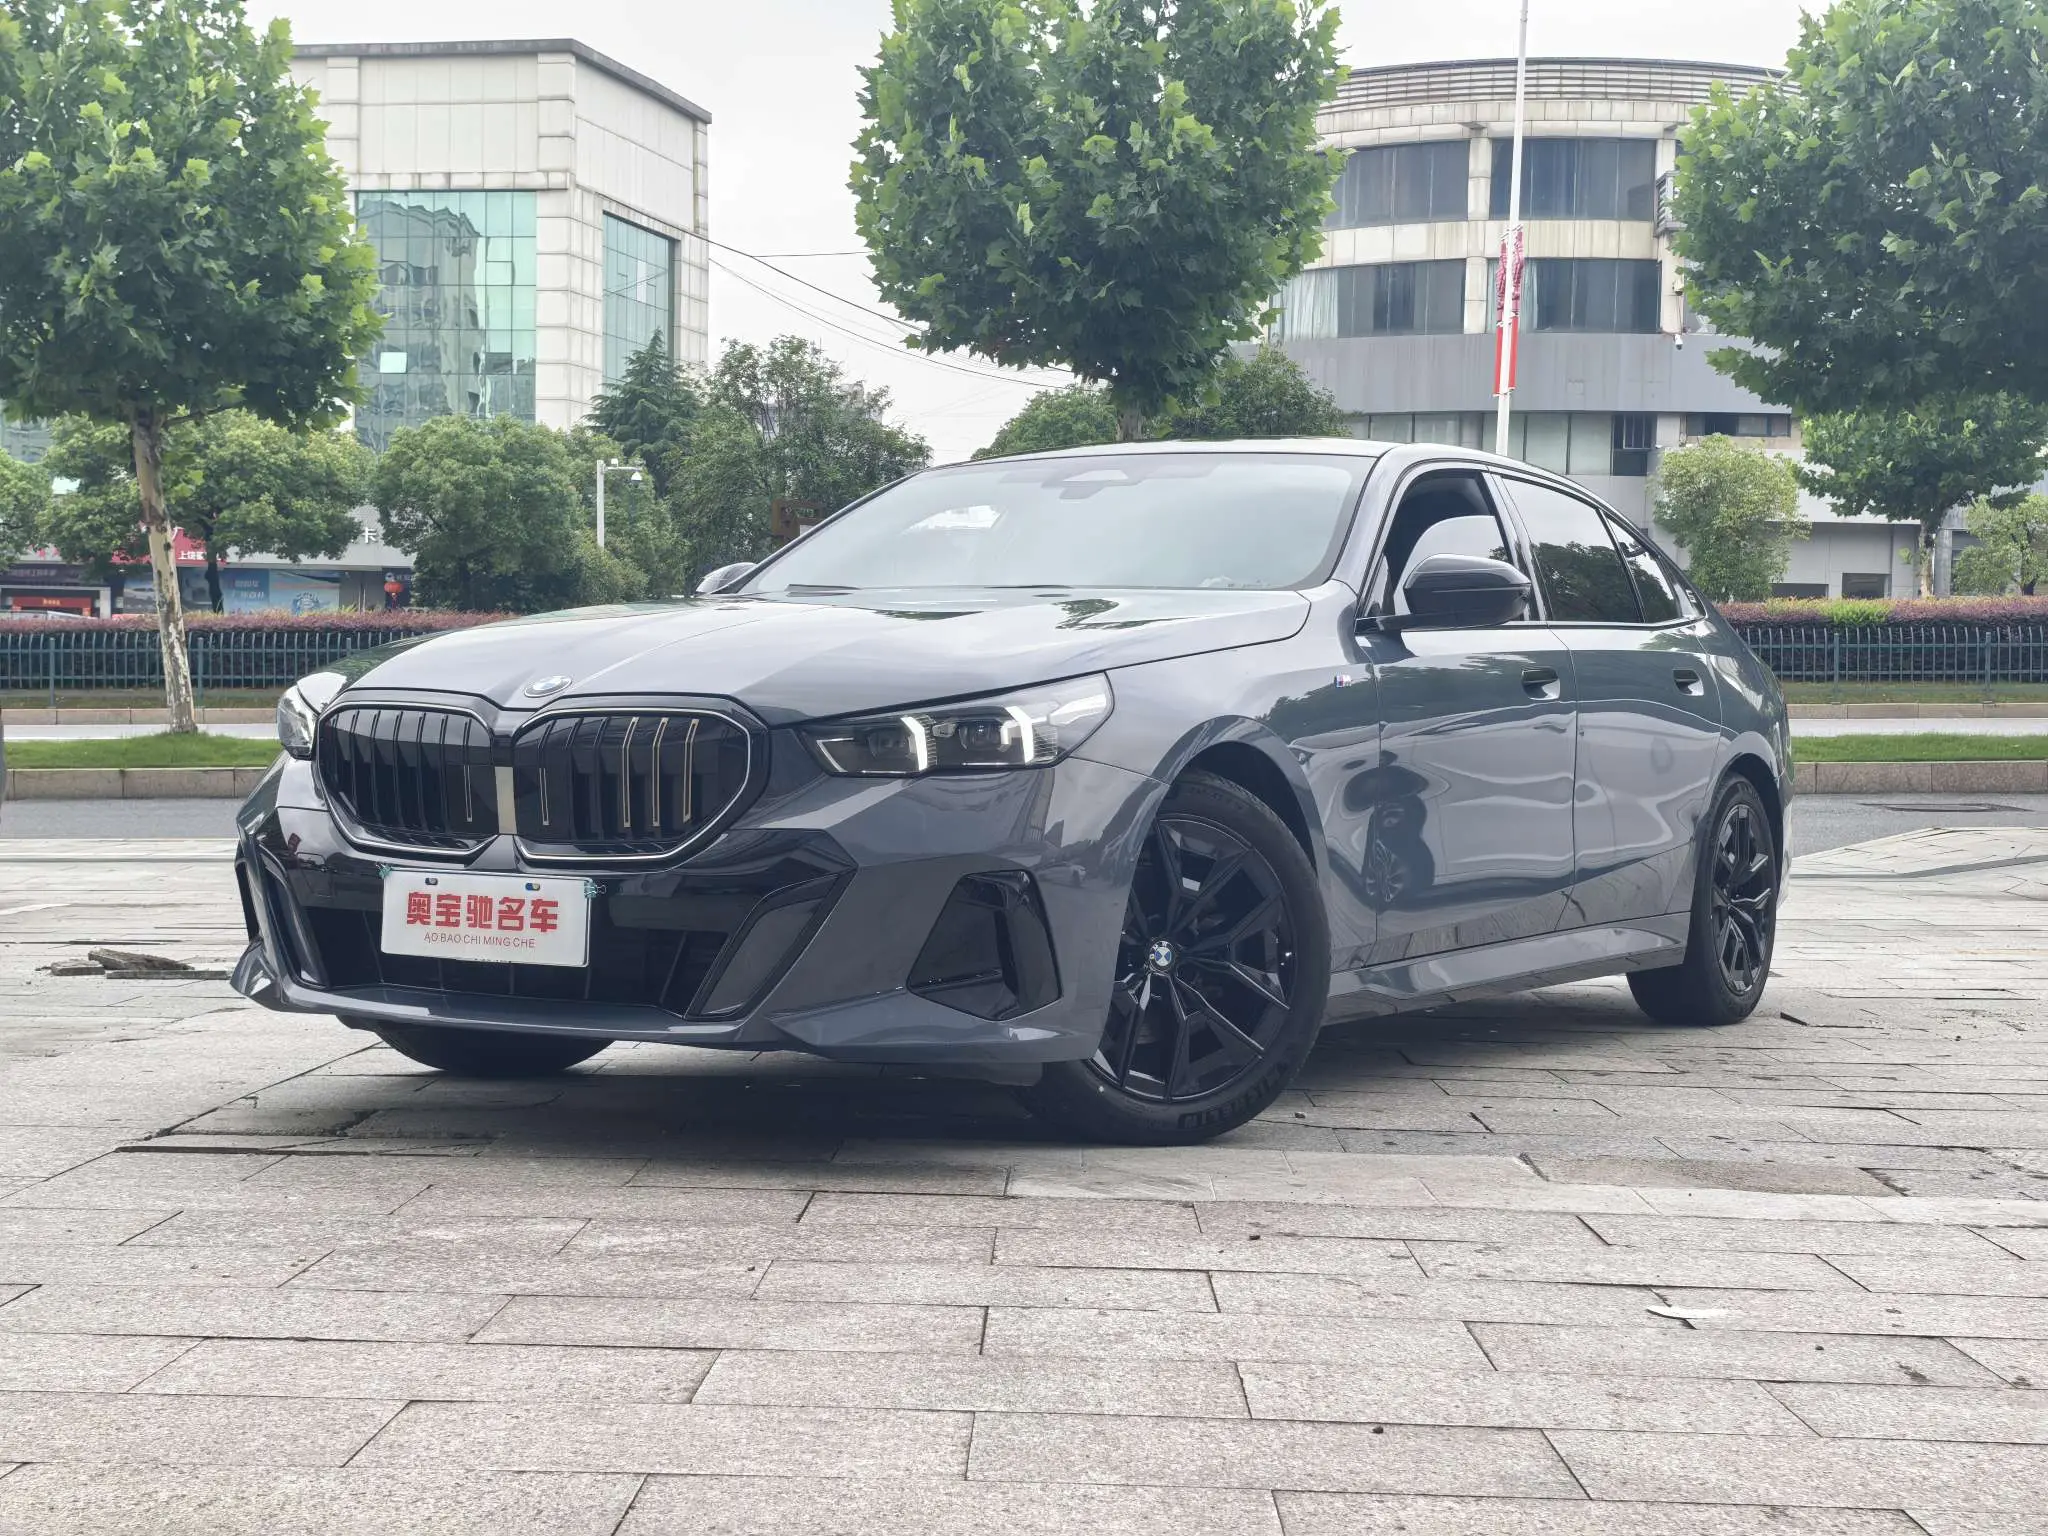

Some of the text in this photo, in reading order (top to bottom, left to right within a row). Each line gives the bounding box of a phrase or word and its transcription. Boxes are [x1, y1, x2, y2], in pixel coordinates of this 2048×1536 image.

[406, 891, 559, 932] 奥宝驰名车
